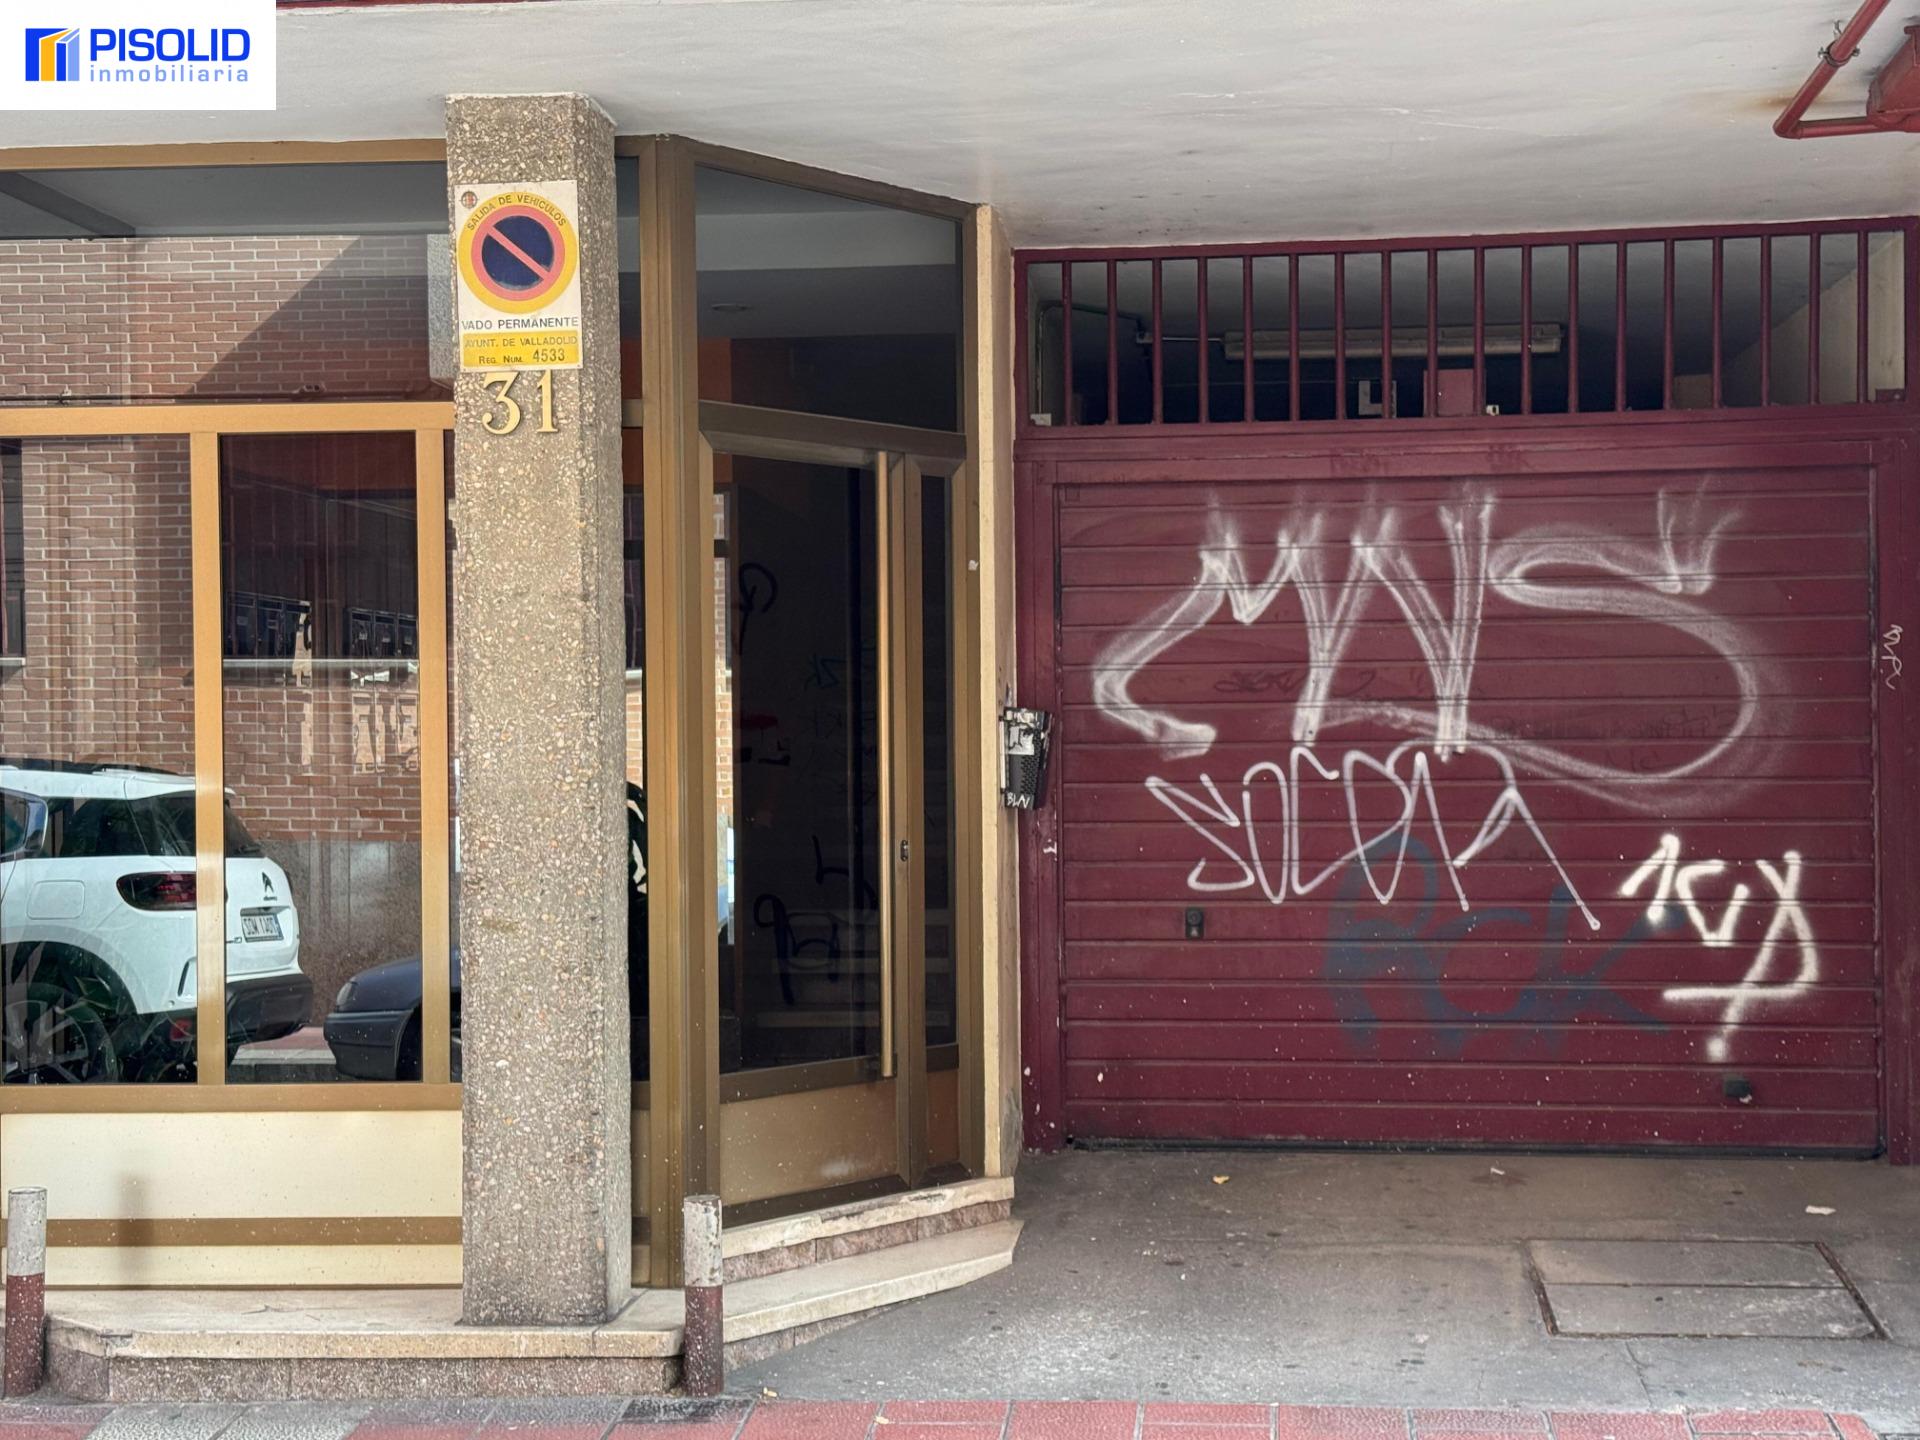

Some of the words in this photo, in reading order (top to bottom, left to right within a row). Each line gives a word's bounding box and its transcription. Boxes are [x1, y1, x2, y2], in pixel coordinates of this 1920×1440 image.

[467, 202, 496, 231] SALIDA
[498, 194, 513, 206] DE
[516, 194, 567, 227] VEHICULOS
[461, 319, 493, 330] VADO
[497, 316, 580, 329] PERMANENTE
[502, 337, 516, 347] DE
[519, 335, 578, 346] VALLADOLID
[532, 347, 566, 362] 4533
[482, 370, 559, 435] 31
